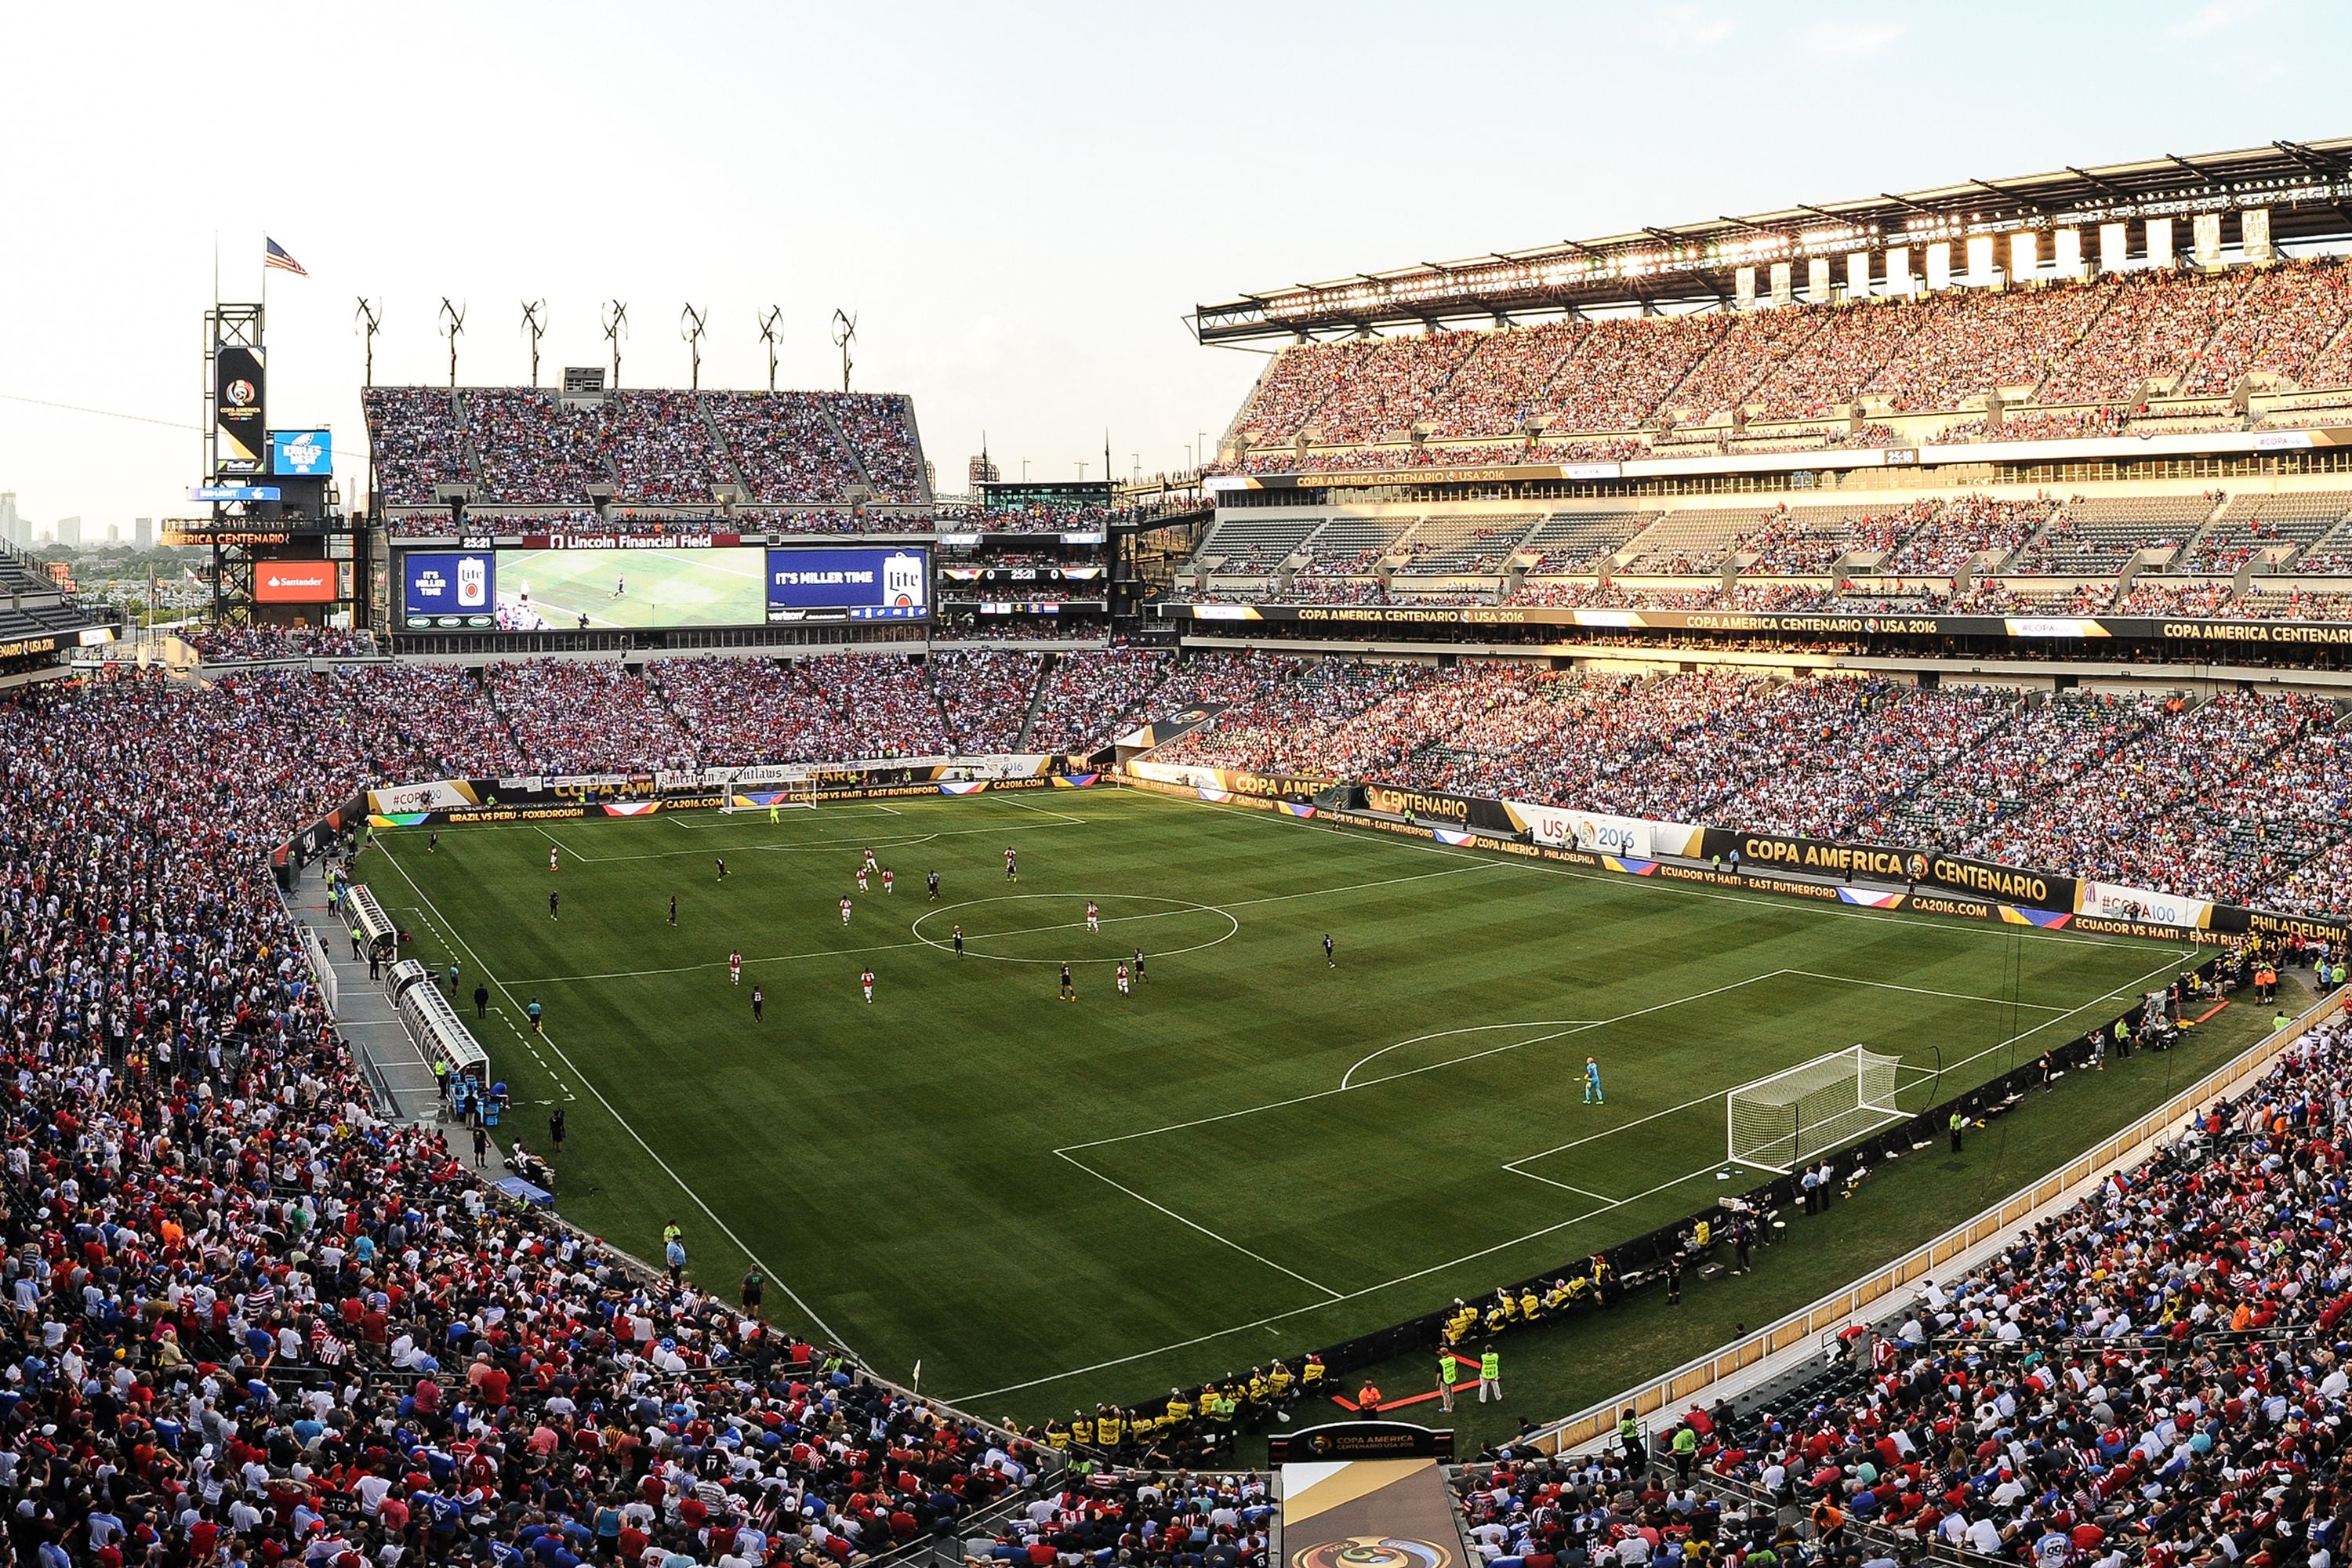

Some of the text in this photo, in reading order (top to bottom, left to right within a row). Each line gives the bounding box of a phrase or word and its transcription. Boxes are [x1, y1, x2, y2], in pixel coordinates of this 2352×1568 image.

[1297, 470, 1505, 487] COPA AMERICA CENTENARIO USA 2016
[217, 533, 284, 544] CENTENARIO
[463, 537, 490, 548] 25:21
[568, 534, 712, 549] Lincoln Financial Field
[281, 577, 323, 586] Santander
[423, 571, 439, 579] IT'S
[775, 571, 873, 585] IT'S MILLER TIME
[889, 572, 918, 591] Lite
[986, 569, 995, 580] 0
[1051, 569, 1058, 580] 0
[1298, 609, 1525, 622] COPA AMERICA CENTENARIO USA 2016
[1686, 615, 1937, 633] COPA AMERICA CENTENARIO USA 2016
[2164, 623, 2201, 637] COPA
[2203, 625, 2269, 641] AMERICA
[30, 640, 42, 653] USA
[42, 638, 55, 651] 2016
[993, 779, 1045, 789] CA2016.COM
[1236, 776, 1278, 796] COPA
[789, 793, 829, 801] ECUADOR
[888, 786, 939, 795] RUTHERFORD
[666, 797, 724, 810] CA2016.COM
[1381, 789, 1468, 818] CENTENARIO
[449, 812, 480, 822] BRAZIL
[481, 812, 492, 821] VS
[494, 811, 517, 821] PERU
[523, 808, 583, 818] FOXBOROUGH
[1354, 817, 1370, 827] HAITI
[1374, 820, 1391, 830] EAST
[1391, 822, 1434, 837] RUTHERFORD
[1543, 818, 1635, 849] USA 2016
[1477, 837, 1595, 866] COPA AMERICA PHILADELPHIA
[1746, 838, 2048, 902] COPA AMERICA CENTENARIO
[1661, 866, 1703, 881] ECUADOR
[1704, 872, 1716, 882] VS
[1717, 874, 1741, 886] HAITI
[1748, 878, 1772, 890] EAST
[1773, 881, 1838, 898] RUTHERFORD
[1911, 896, 1987, 916] CA2016.COM
[2074, 917, 2129, 935] ECUADOR
[2132, 924, 2147, 935] VS
[2148, 926, 2180, 939] HAITI
[2190, 931, 2218, 944] EAST
[2250, 914, 2347, 942] PHILADELPHIA
[182, 1306, 188, 1317] 8
[1873, 1411, 1881, 1423] 9
[329, 1450, 337, 1462] 5
[849, 1456, 857, 1466] 6
[474, 1465, 485, 1476] 19
[706, 1459, 717, 1471] 17
[2046, 1544, 2063, 1559] 99
[1258, 1557, 1265, 1566] 8
